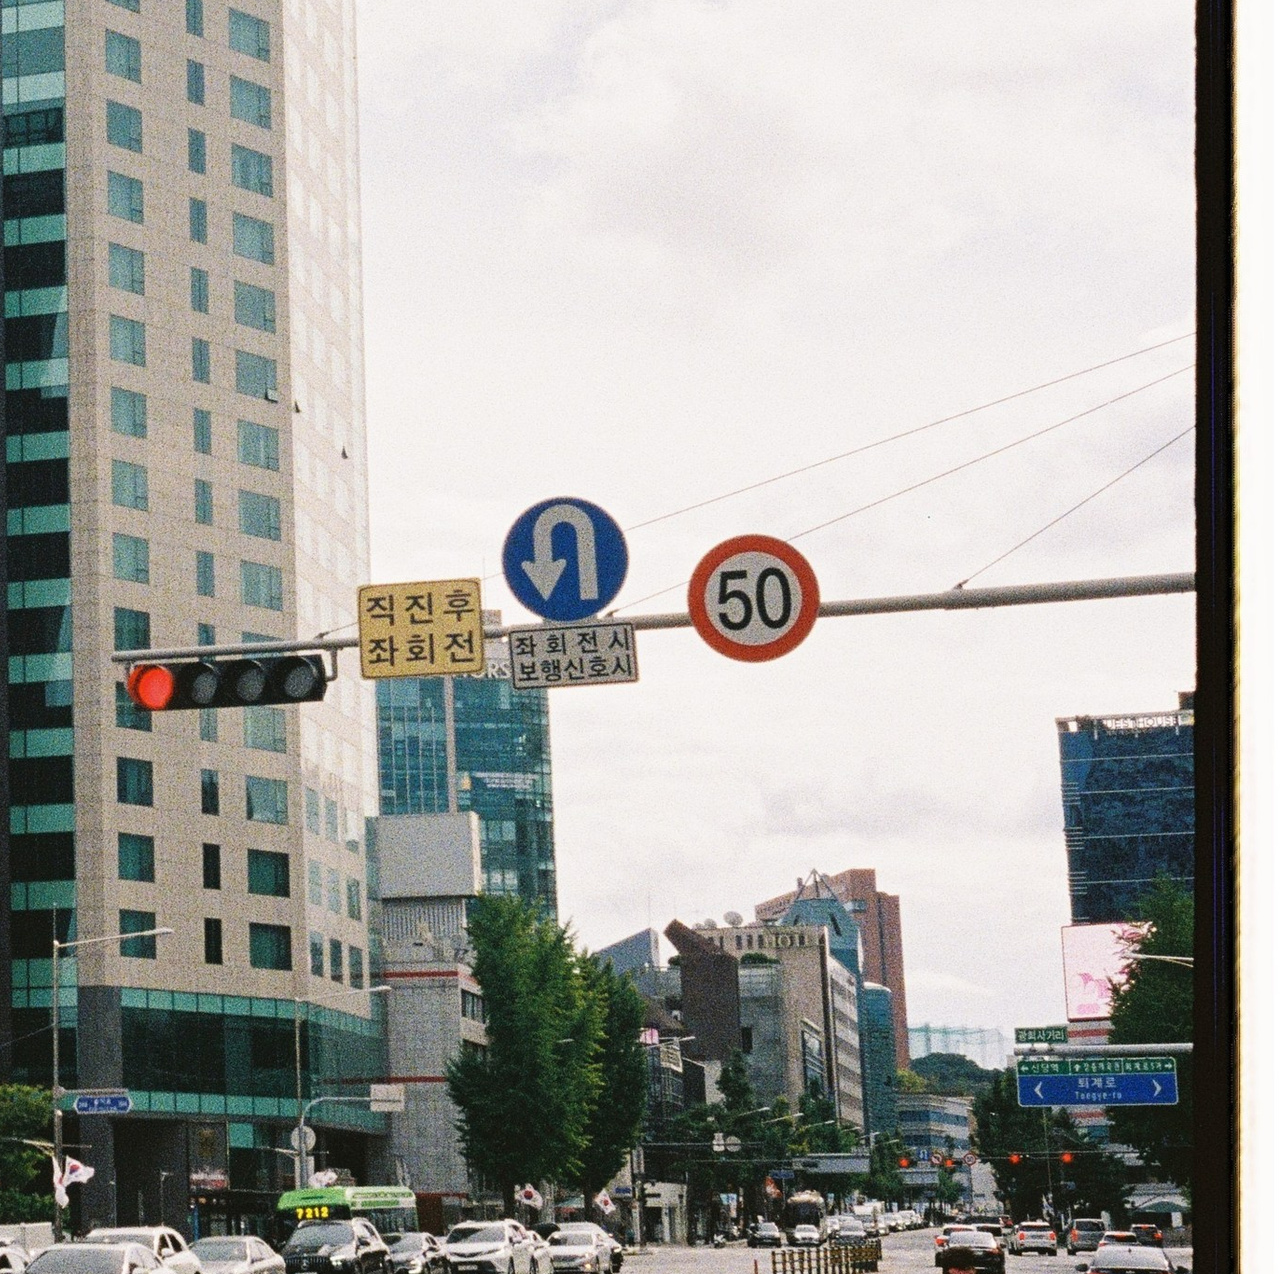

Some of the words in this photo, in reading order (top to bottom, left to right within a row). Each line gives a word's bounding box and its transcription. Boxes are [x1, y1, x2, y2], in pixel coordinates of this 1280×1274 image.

[366, 589, 474, 626] 직진후
[718, 567, 792, 631] 50
[368, 630, 475, 666] 좌회전
[516, 628, 629, 657] 좌회전시
[518, 654, 632, 682] 보행신호시
[1031, 1063, 1059, 1073] 신당역
[1075, 1091, 1123, 1102] Toegye-ro
[1078, 1076, 1117, 1089] 퇴계로
[295, 1206, 330, 1220] 7212
